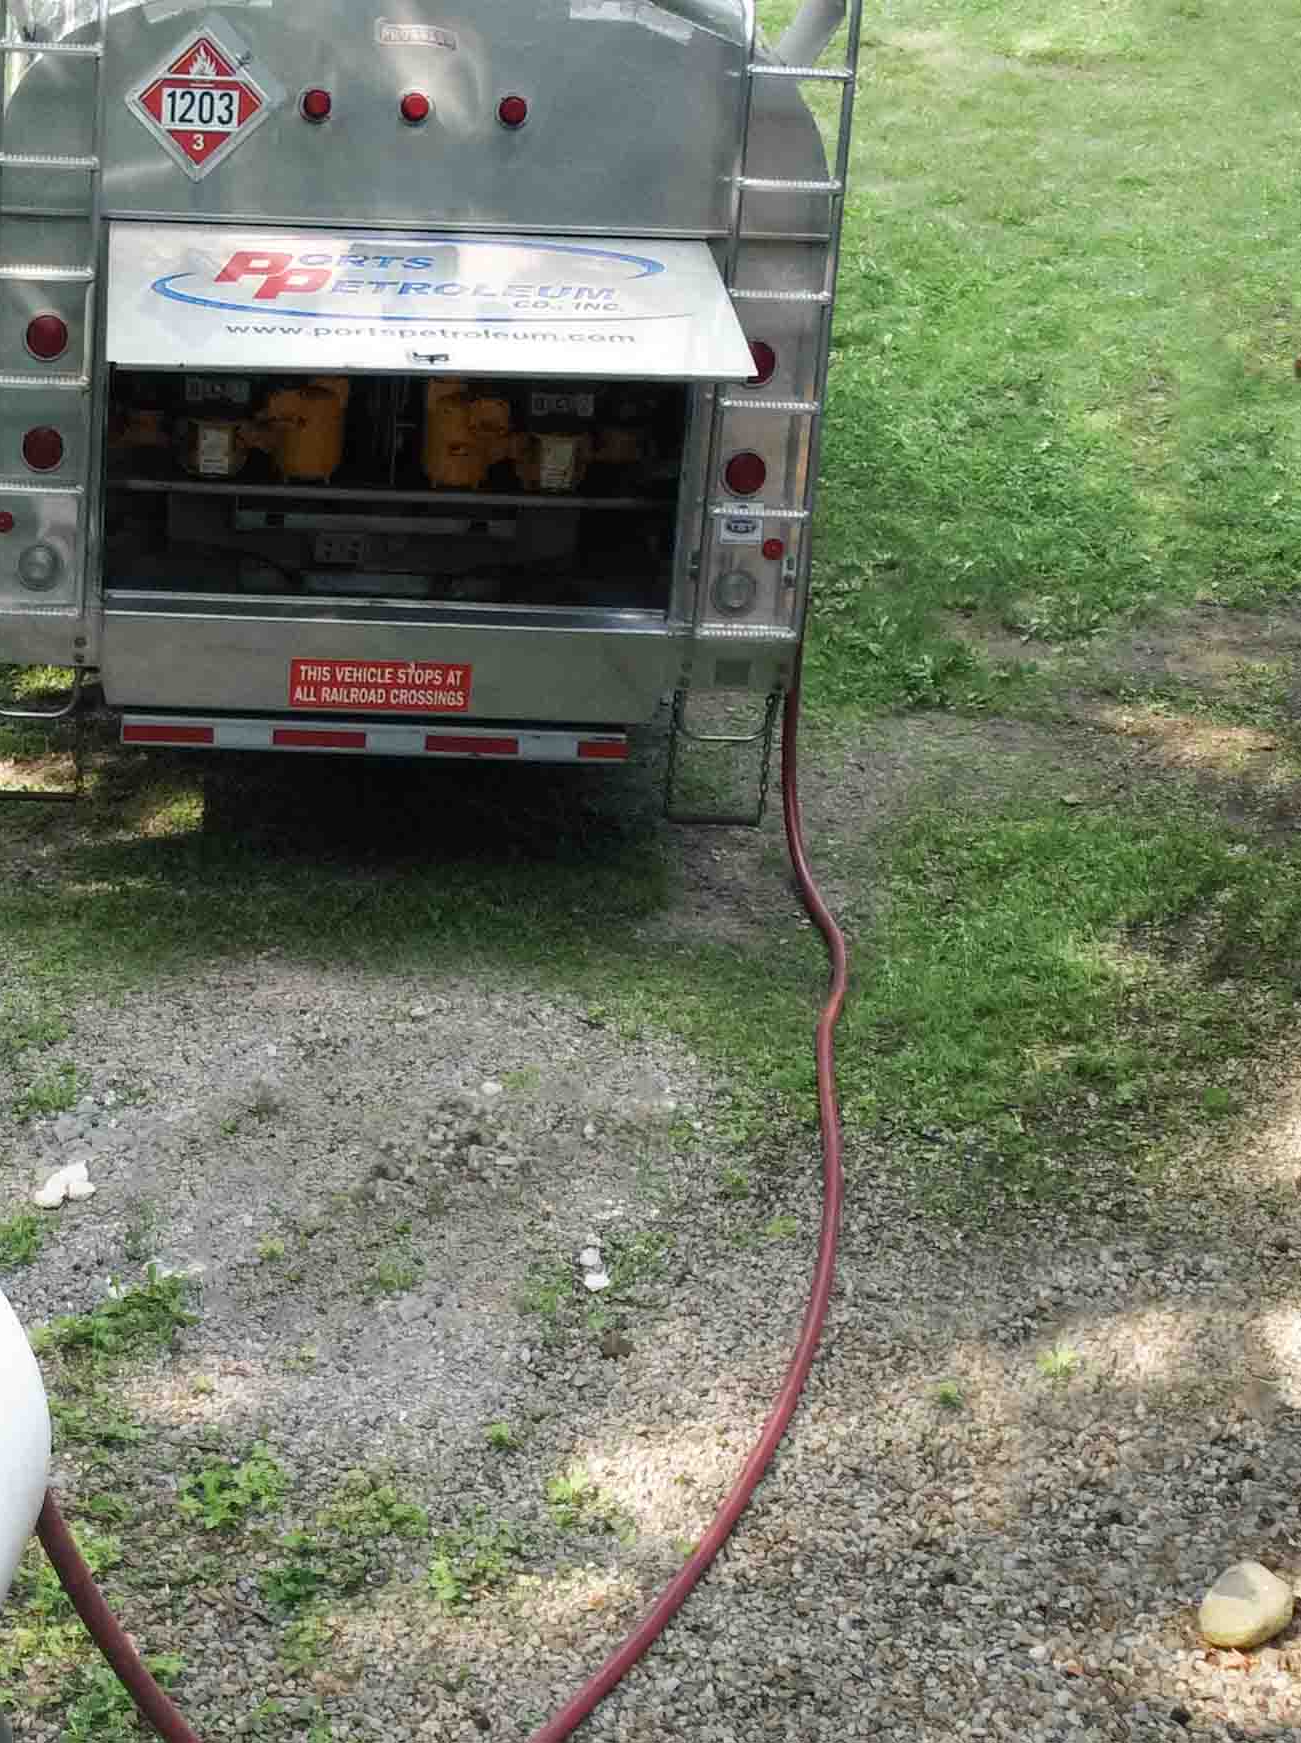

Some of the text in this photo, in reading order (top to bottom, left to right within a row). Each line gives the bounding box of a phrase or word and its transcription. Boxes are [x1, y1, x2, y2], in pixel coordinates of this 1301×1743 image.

[166, 90, 234, 125] 1203
[192, 133, 205, 151] 3
[214, 250, 436, 283] PORTS
[252, 268, 616, 300] PETROLEUM
[226, 324, 636, 343] www.portspetroleum.com
[300, 665, 463, 686] THIS VEHICLE STOPS AT
[293, 686, 464, 706] ALL RAILROAD CROSSINGS
